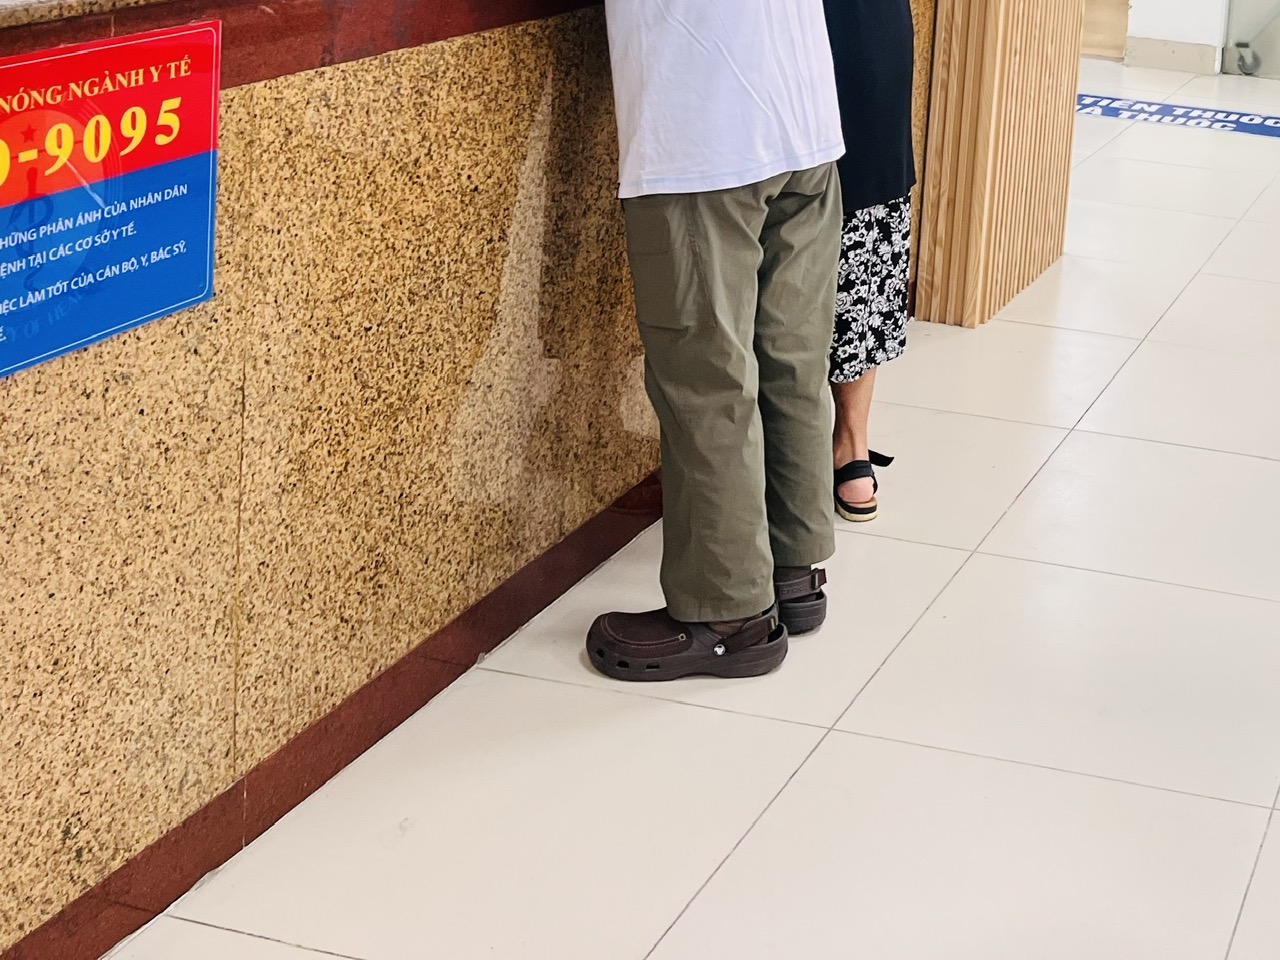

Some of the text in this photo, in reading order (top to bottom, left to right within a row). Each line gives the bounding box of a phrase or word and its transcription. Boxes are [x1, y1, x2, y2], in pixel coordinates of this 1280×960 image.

[0, 54, 191, 114] NÓNG NGÀNH Y TẾ
[1080, 96, 1163, 112] TIỀN
[1118, 111, 1237, 131] THUỐC
[39, 183, 188, 238] PHẢN ÁNH CỦA NHÂN DÂN
[28, 250, 47, 269] TẠI
[49, 240, 72, 261] CÁC
[75, 236, 93, 252] CƠ
[94, 230, 110, 247] SỞ
[111, 228, 121, 240] Y
[121, 221, 137, 238] TẾ.
[19, 288, 45, 308] LÀM
[46, 280, 69, 297] TỐT
[70, 272, 94, 290] CỦA
[96, 264, 119, 281] CÁN
[121, 256, 139, 273] BỘ,
[140, 253, 149, 268] Y,
[151, 245, 171, 263] BÁC
